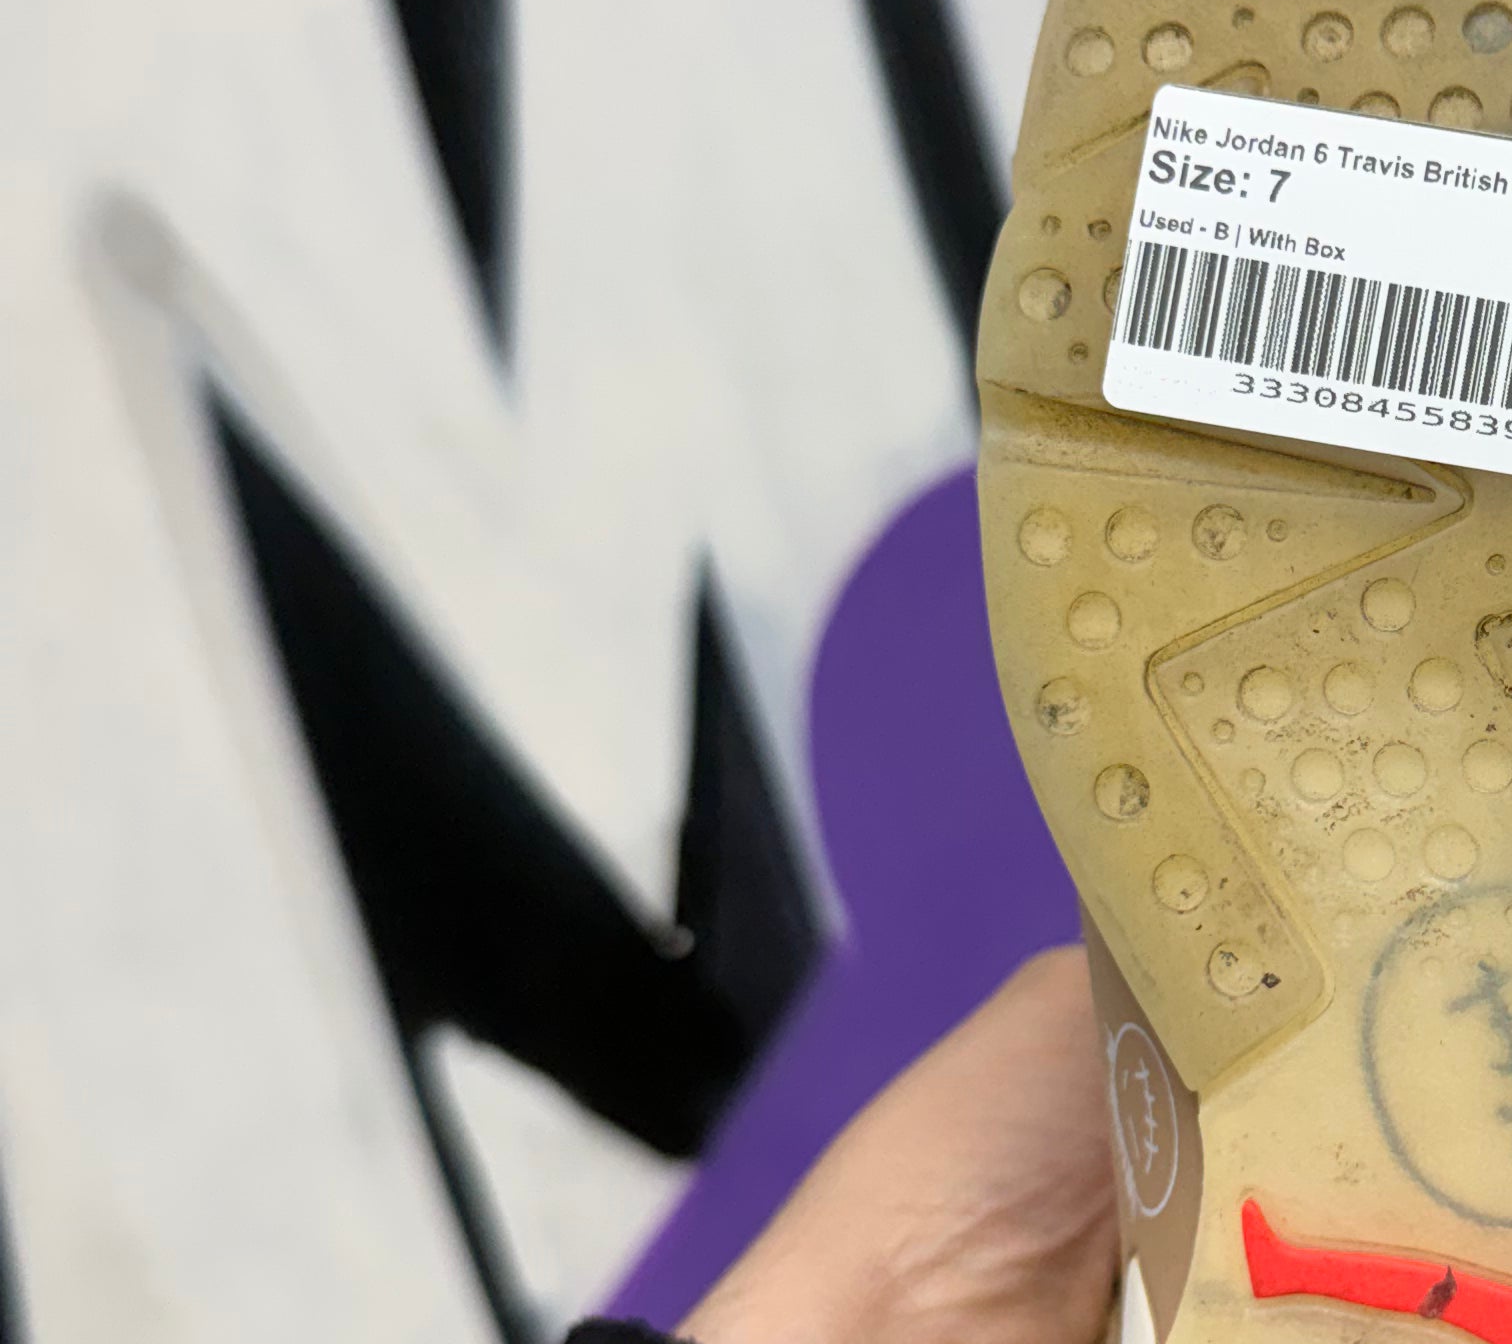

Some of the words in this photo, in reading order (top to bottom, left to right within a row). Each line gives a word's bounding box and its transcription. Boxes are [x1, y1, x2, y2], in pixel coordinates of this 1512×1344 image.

[1148, 149, 1251, 198] Size:
[1268, 169, 1291, 203] 7
[1152, 116, 1208, 146] Nike
[1216, 127, 1306, 162] Jordan
[1313, 143, 1328, 164] 6
[1338, 147, 1415, 180] Travis
[1423, 161, 1508, 194] British
[1139, 209, 1194, 236] Used
[1214, 222, 1229, 240] B
[1248, 227, 1297, 253] With
[1305, 236, 1346, 262] Box
